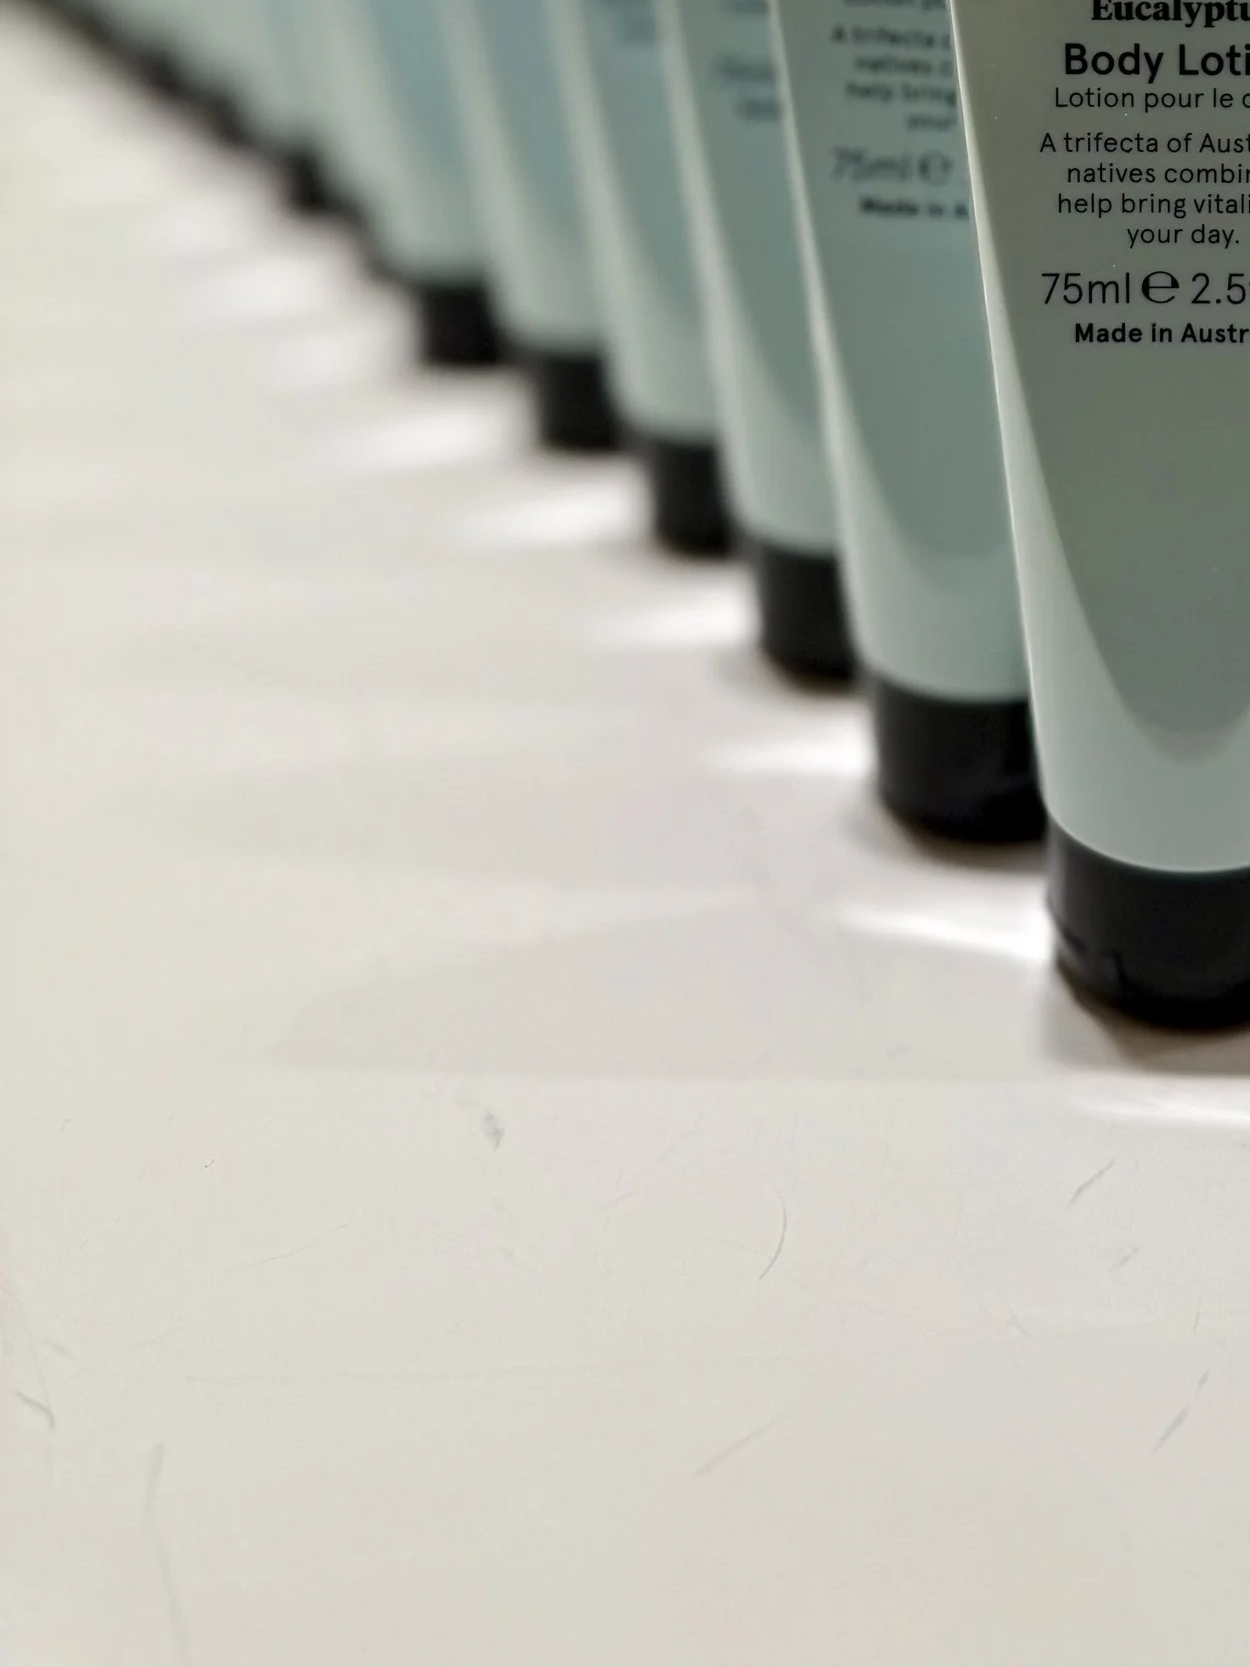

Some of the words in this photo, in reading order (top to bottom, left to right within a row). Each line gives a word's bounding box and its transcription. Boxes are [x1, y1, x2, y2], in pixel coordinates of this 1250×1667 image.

[1063, 42, 1165, 84] Body
[1054, 87, 1135, 109] Lotion
[1144, 92, 1205, 113] pour
[1212, 87, 1234, 109] le
[1039, 132, 1058, 154] A
[1063, 132, 1160, 155] trifecta
[1166, 132, 1193, 155] of
[1066, 162, 1157, 184] natives
[1057, 192, 1113, 220] help
[1121, 193, 1188, 220] bring
[1126, 227, 1184, 250] your
[1190, 223, 1241, 250] day.
[1040, 272, 1131, 305] 75ml
[1074, 322, 1143, 344] Made
[1151, 322, 1174, 344] in
